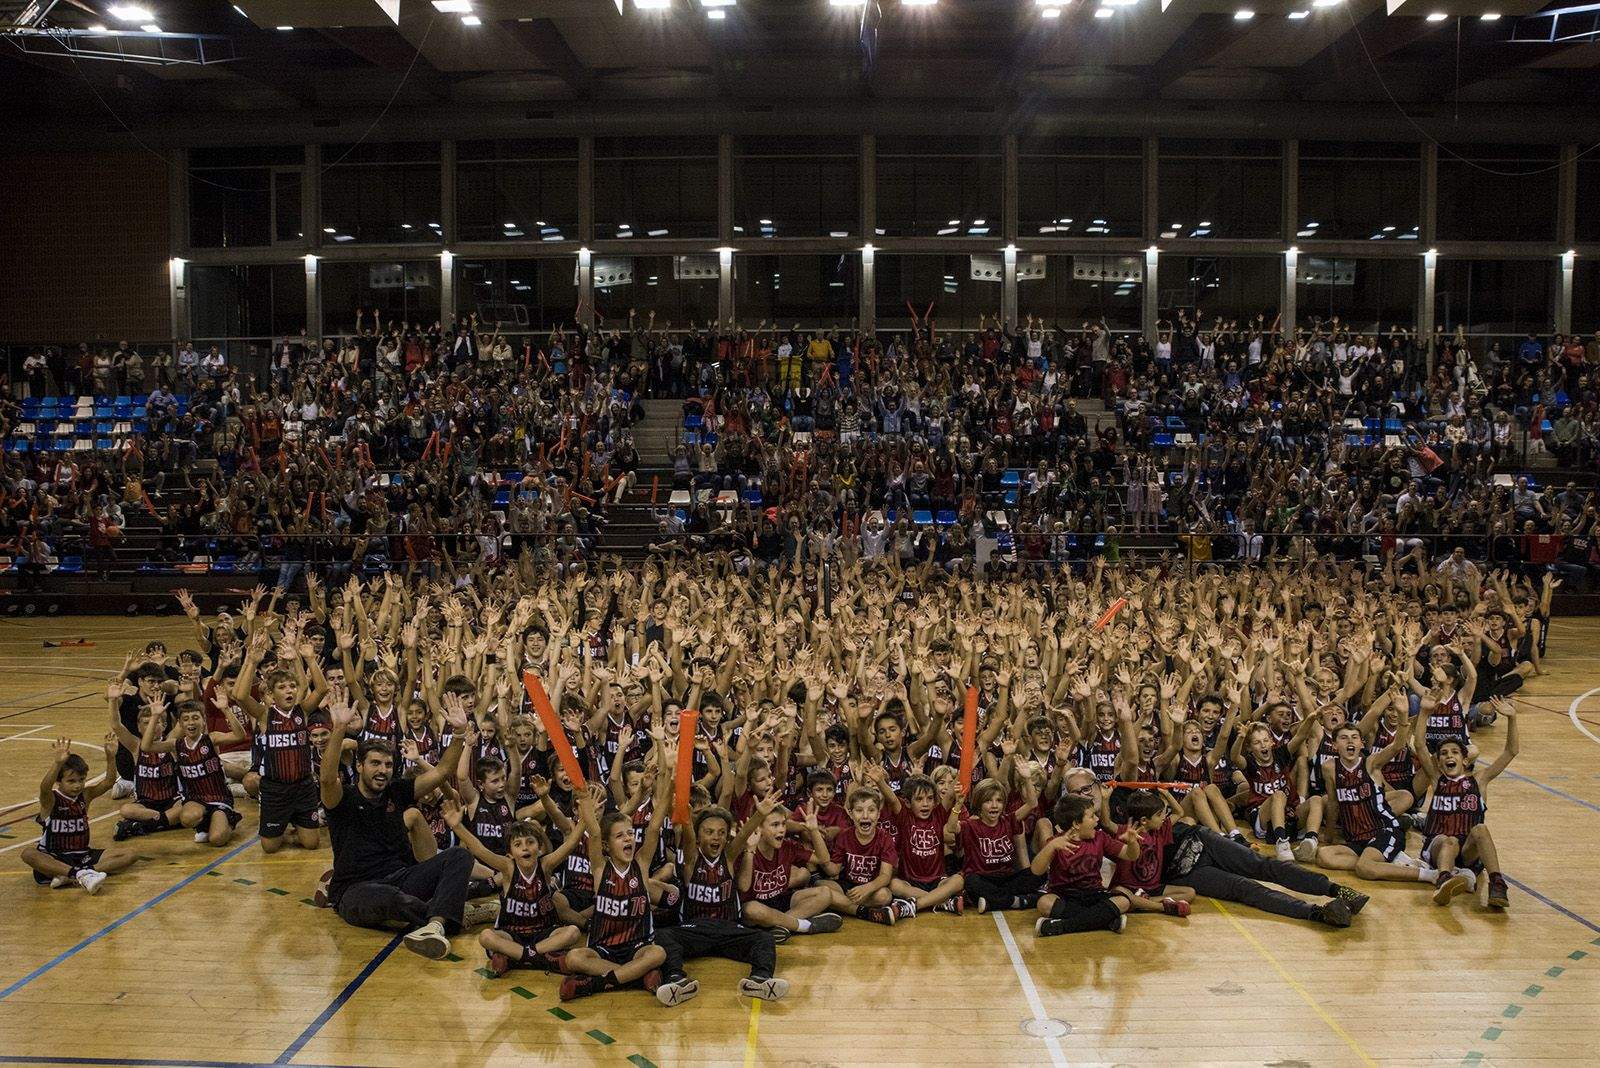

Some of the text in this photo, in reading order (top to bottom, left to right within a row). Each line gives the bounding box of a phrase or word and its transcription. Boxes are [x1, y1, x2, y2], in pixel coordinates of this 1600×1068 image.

[268, 732, 297, 748] UESC
[1432, 796, 1461, 811] UESC
[51, 819, 84, 833] UESC
[477, 823, 502, 838] UESC
[688, 882, 721, 904] UESC
[505, 897, 538, 918] UESC
[596, 895, 629, 917] UESC
